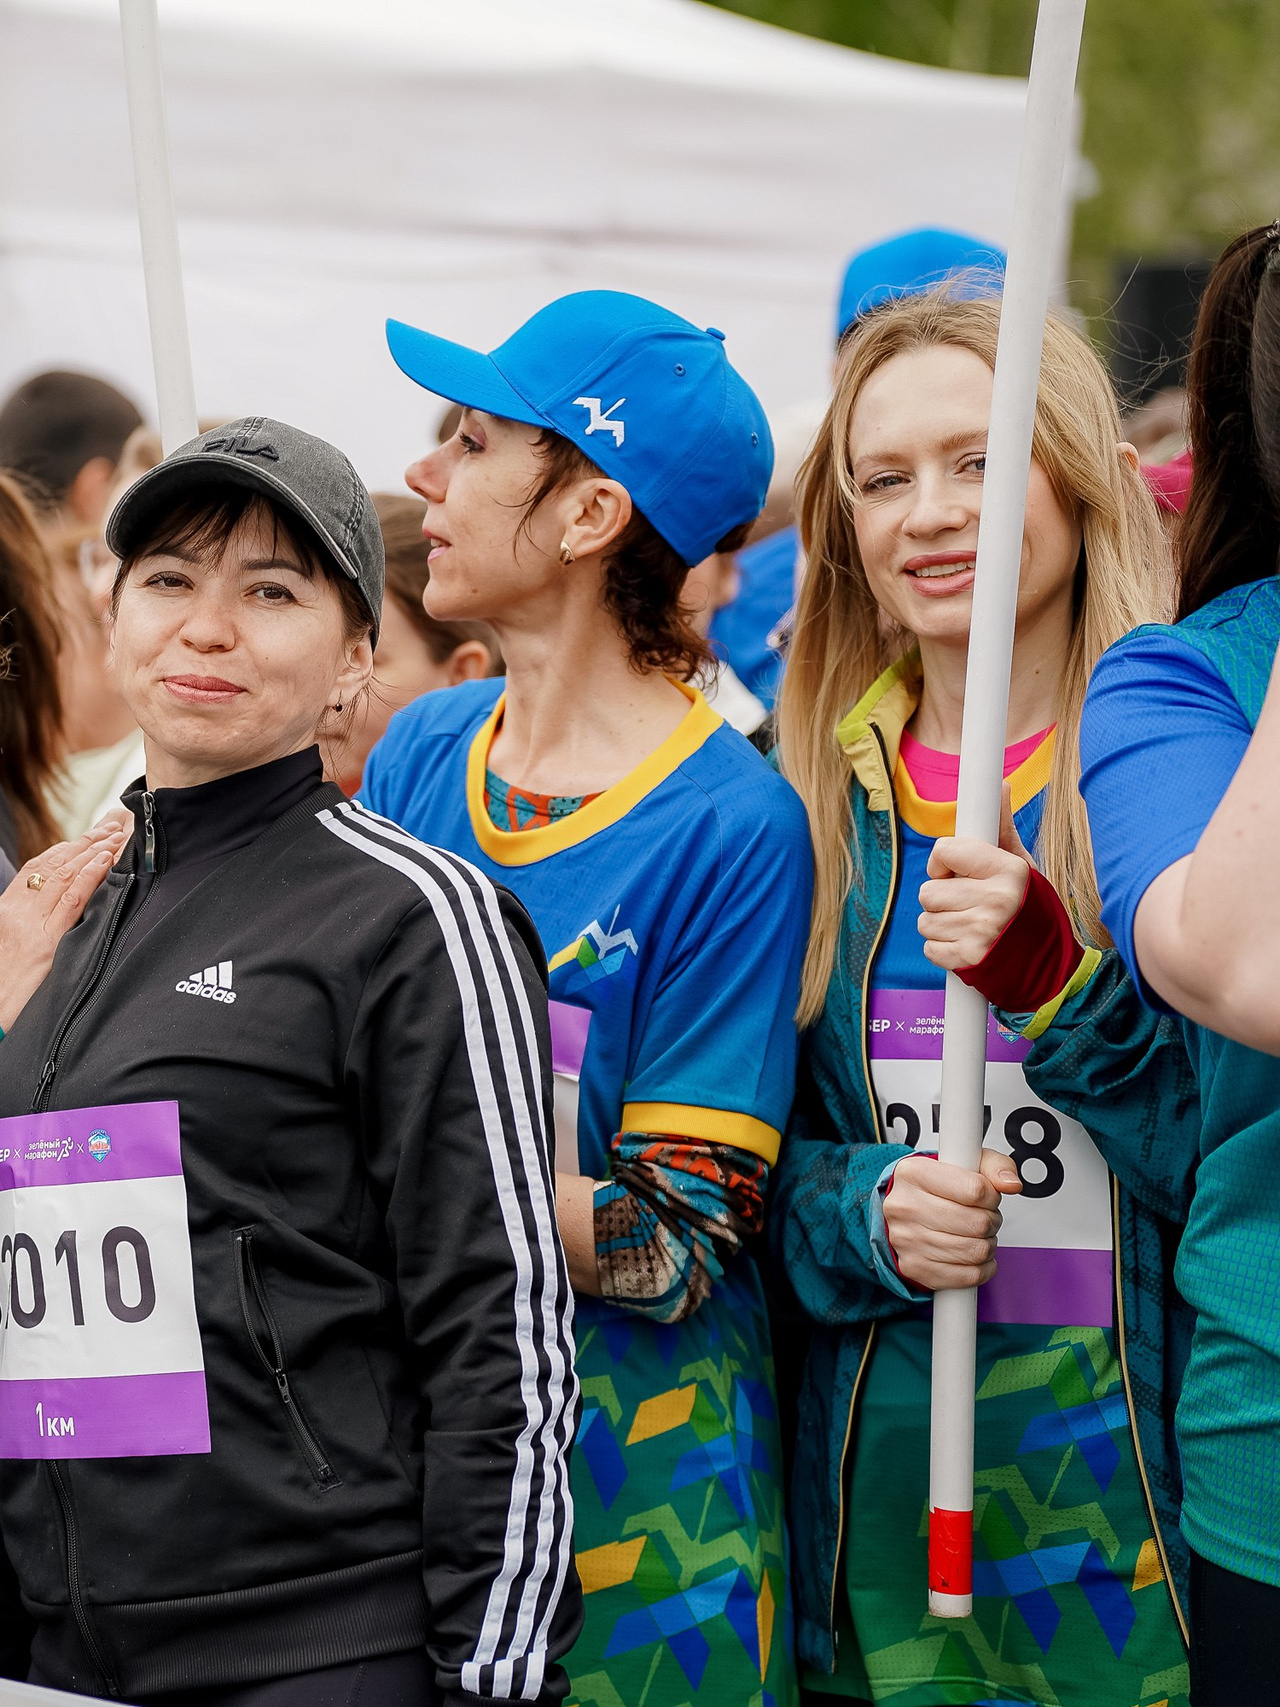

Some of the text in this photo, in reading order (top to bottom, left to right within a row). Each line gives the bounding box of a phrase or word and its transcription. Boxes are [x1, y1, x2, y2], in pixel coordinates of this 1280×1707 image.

[202, 435, 280, 463] FILA
[175, 980, 237, 1004] adidas
[915, 1016, 945, 1025] зелён
[909, 1026, 945, 1036] марафо
[28, 1138, 60, 1150] зелёный
[24, 1150, 58, 1161] марафон
